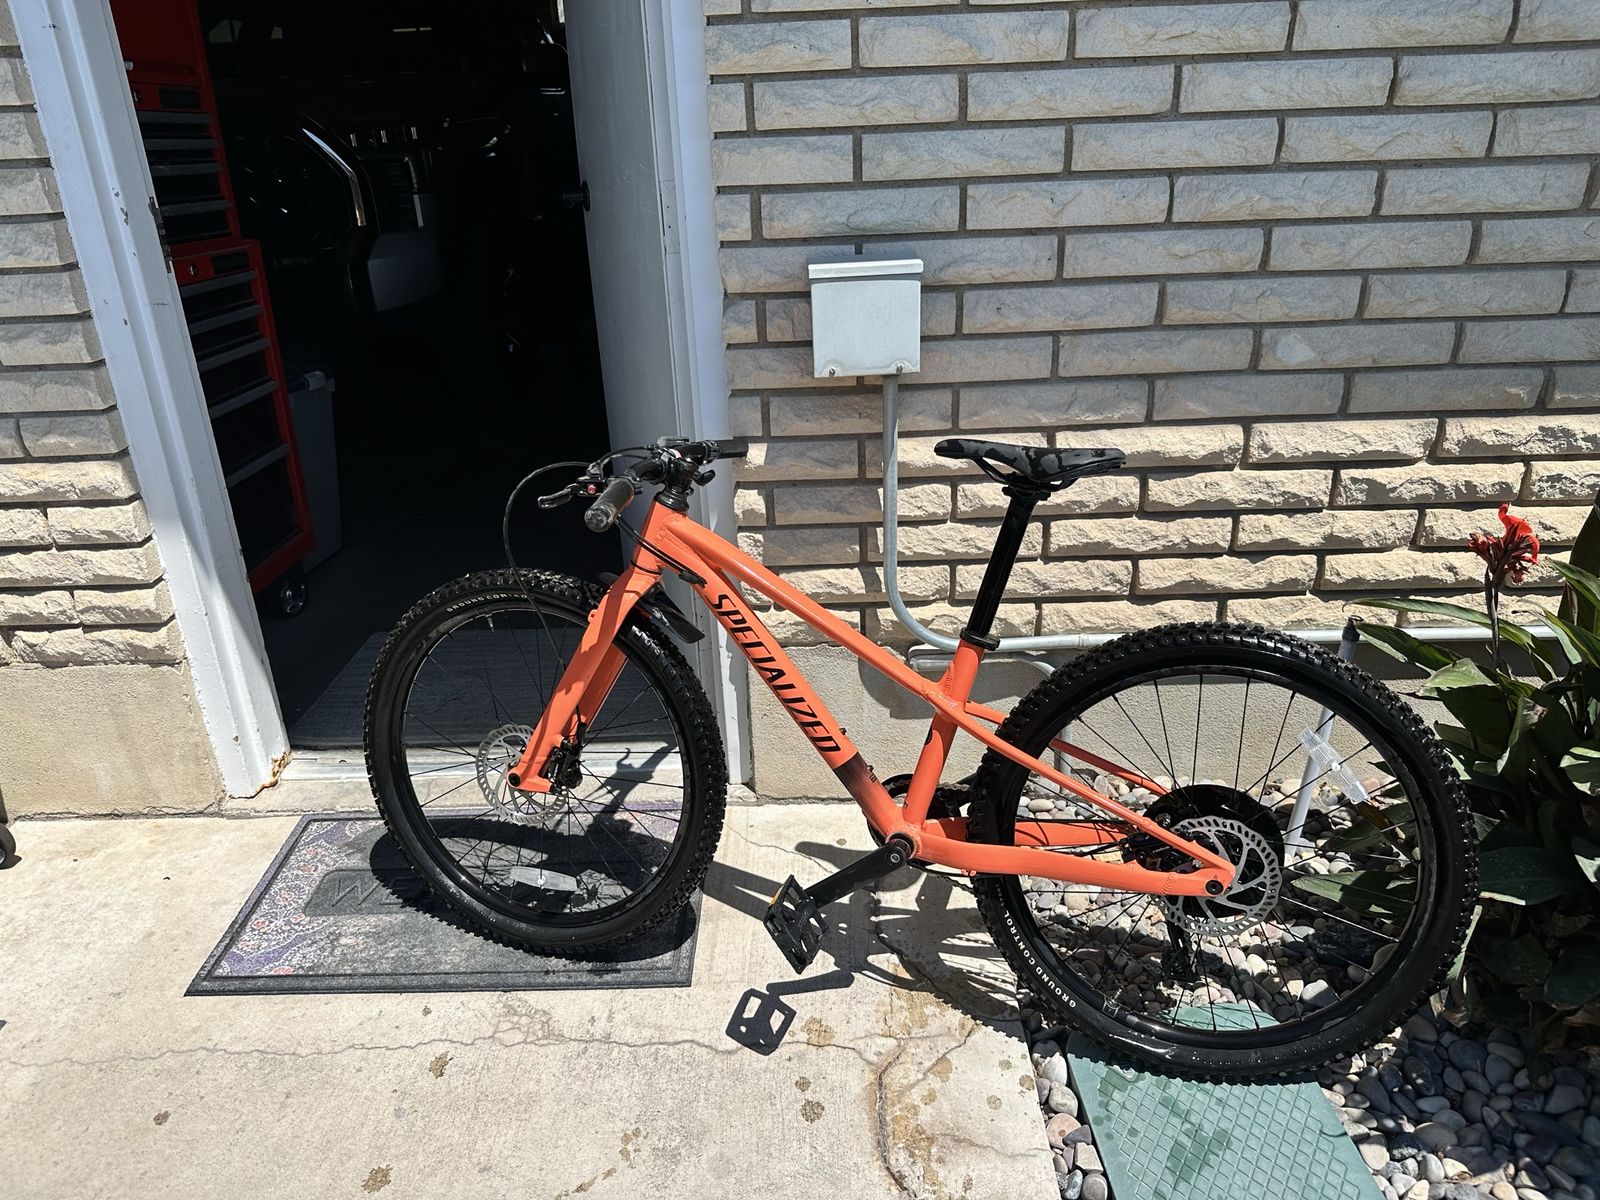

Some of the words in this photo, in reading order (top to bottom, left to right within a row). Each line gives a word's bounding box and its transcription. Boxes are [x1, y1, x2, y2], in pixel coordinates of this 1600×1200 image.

[446, 596, 485, 612] GROUND
[705, 594, 842, 752] SPECIALIZED
[1003, 910, 1036, 965] CONTROL
[1035, 966, 1076, 1008] GROUND
